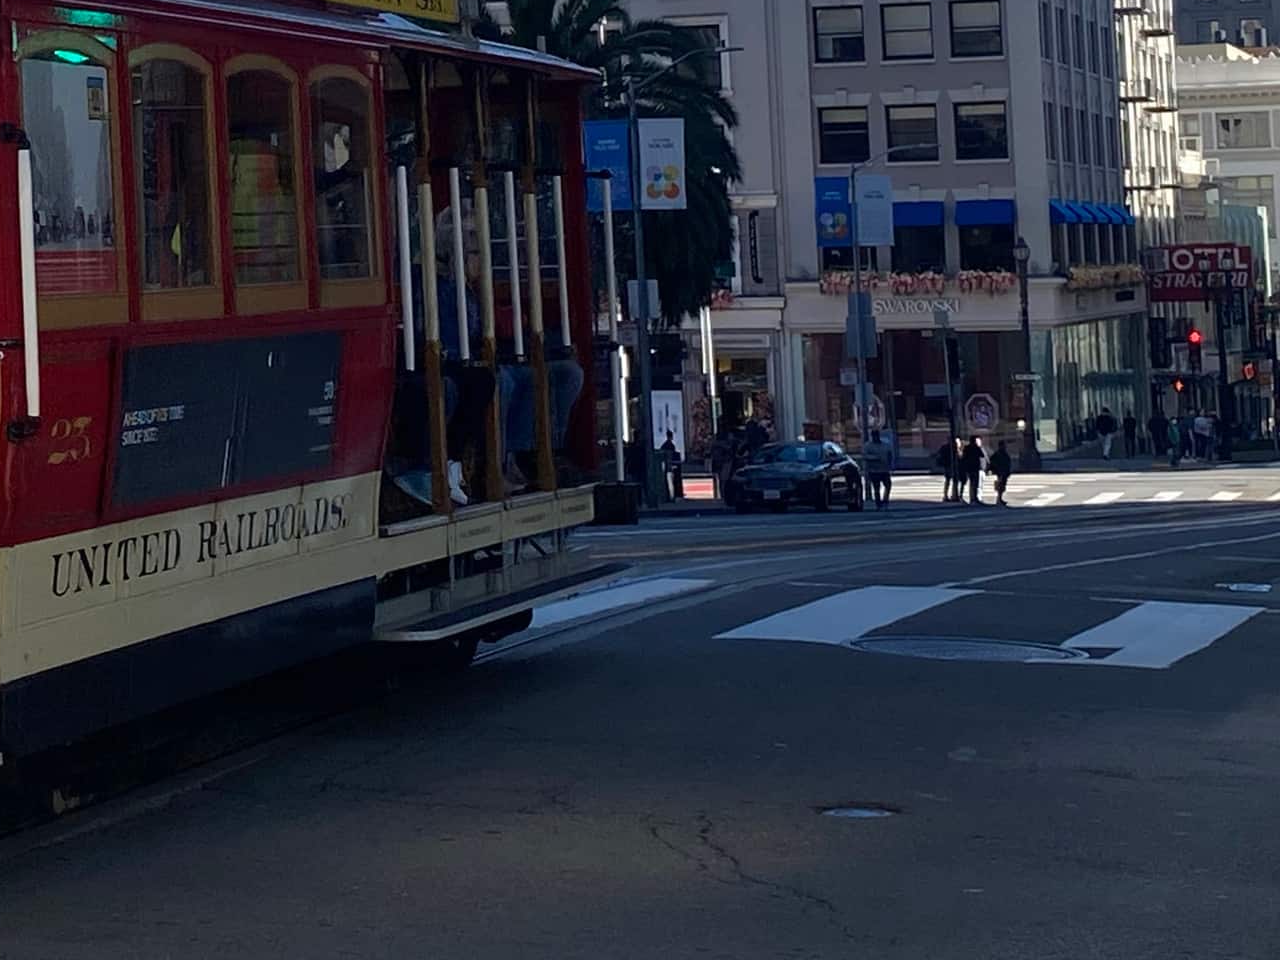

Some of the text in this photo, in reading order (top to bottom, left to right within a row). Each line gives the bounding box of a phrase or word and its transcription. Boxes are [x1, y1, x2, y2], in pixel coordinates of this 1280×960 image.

[1163, 247, 1249, 271] OTEL
[873, 298, 961, 314] SWAROVSKI
[52, 527, 182, 598] UNITED
